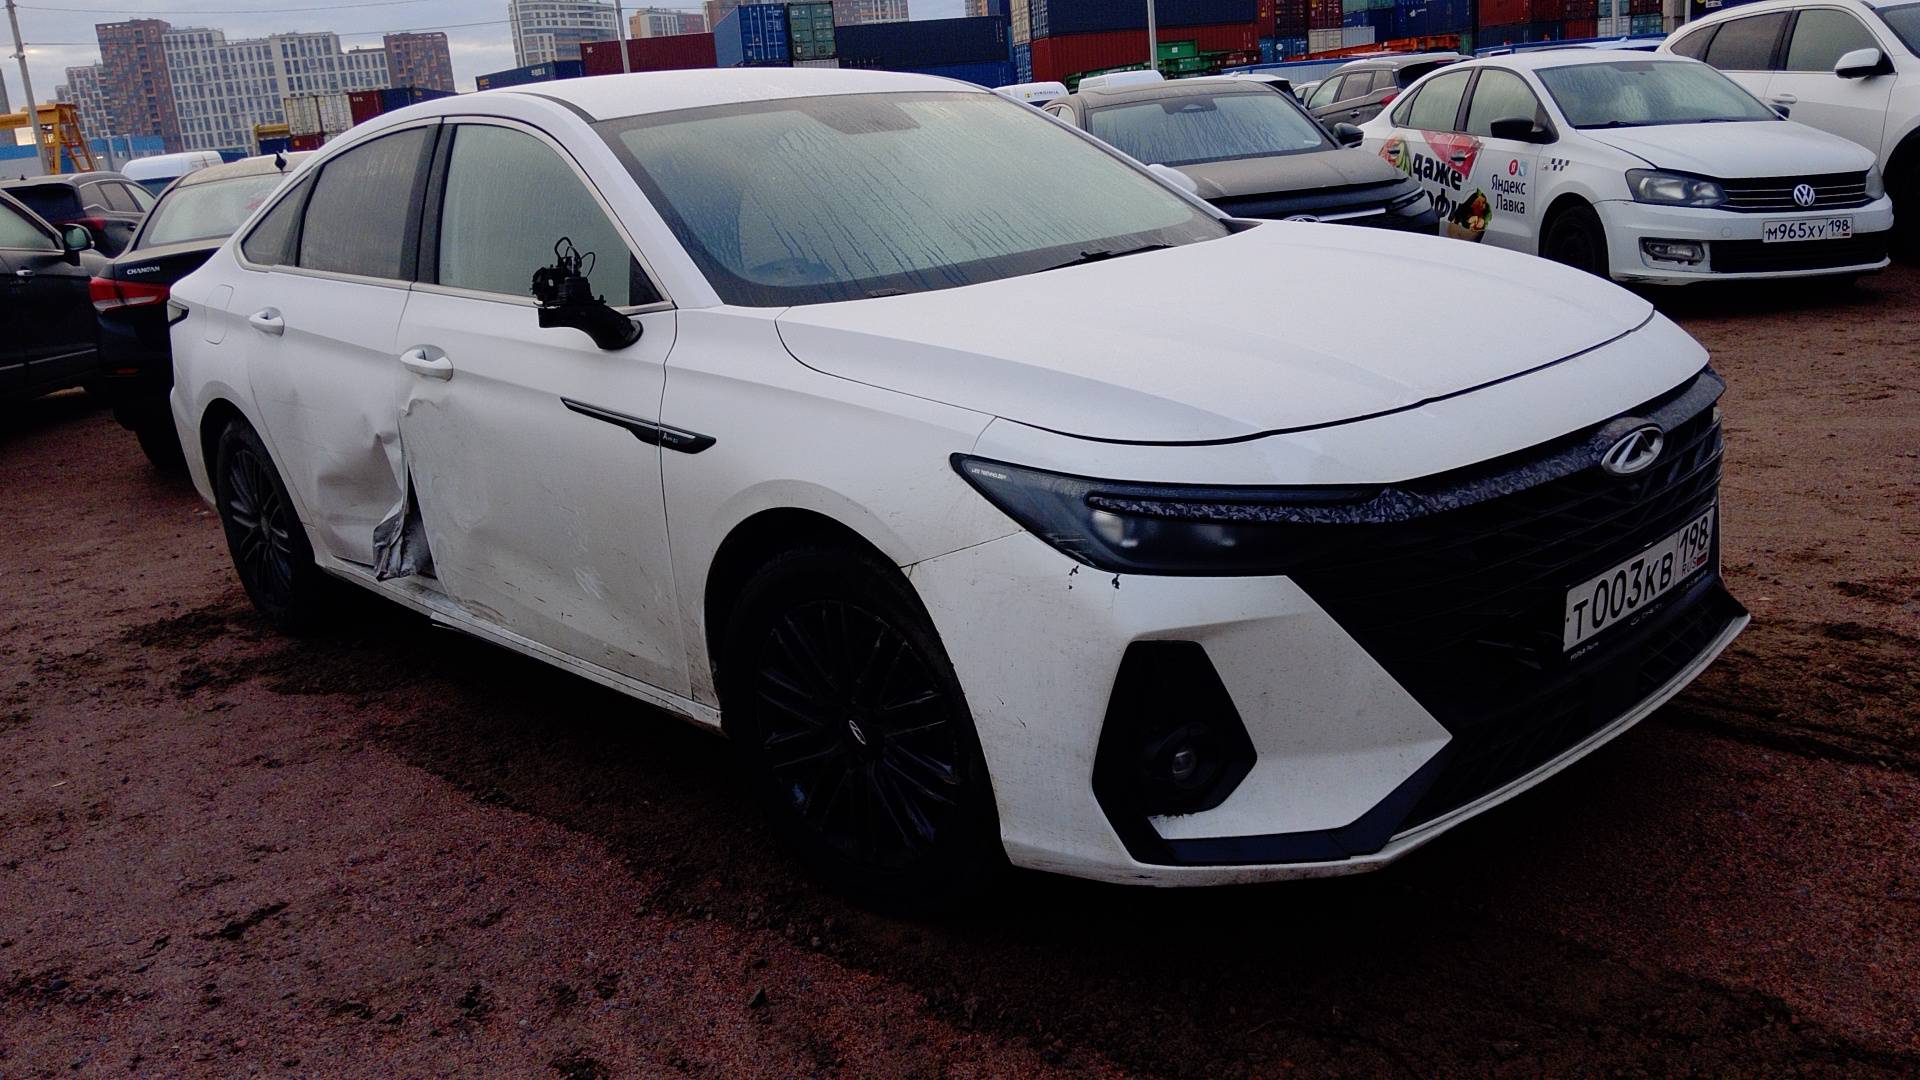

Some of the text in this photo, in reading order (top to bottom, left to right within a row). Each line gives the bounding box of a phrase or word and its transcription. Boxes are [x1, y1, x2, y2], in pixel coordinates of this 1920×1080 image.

[1413, 153, 1462, 191] даже
[1491, 174, 1526, 195] Яндекс
[1496, 194, 1525, 214] Лавка
[1829, 219, 1850, 232] 198
[1573, 516, 1709, 640] Т003КВ 198
